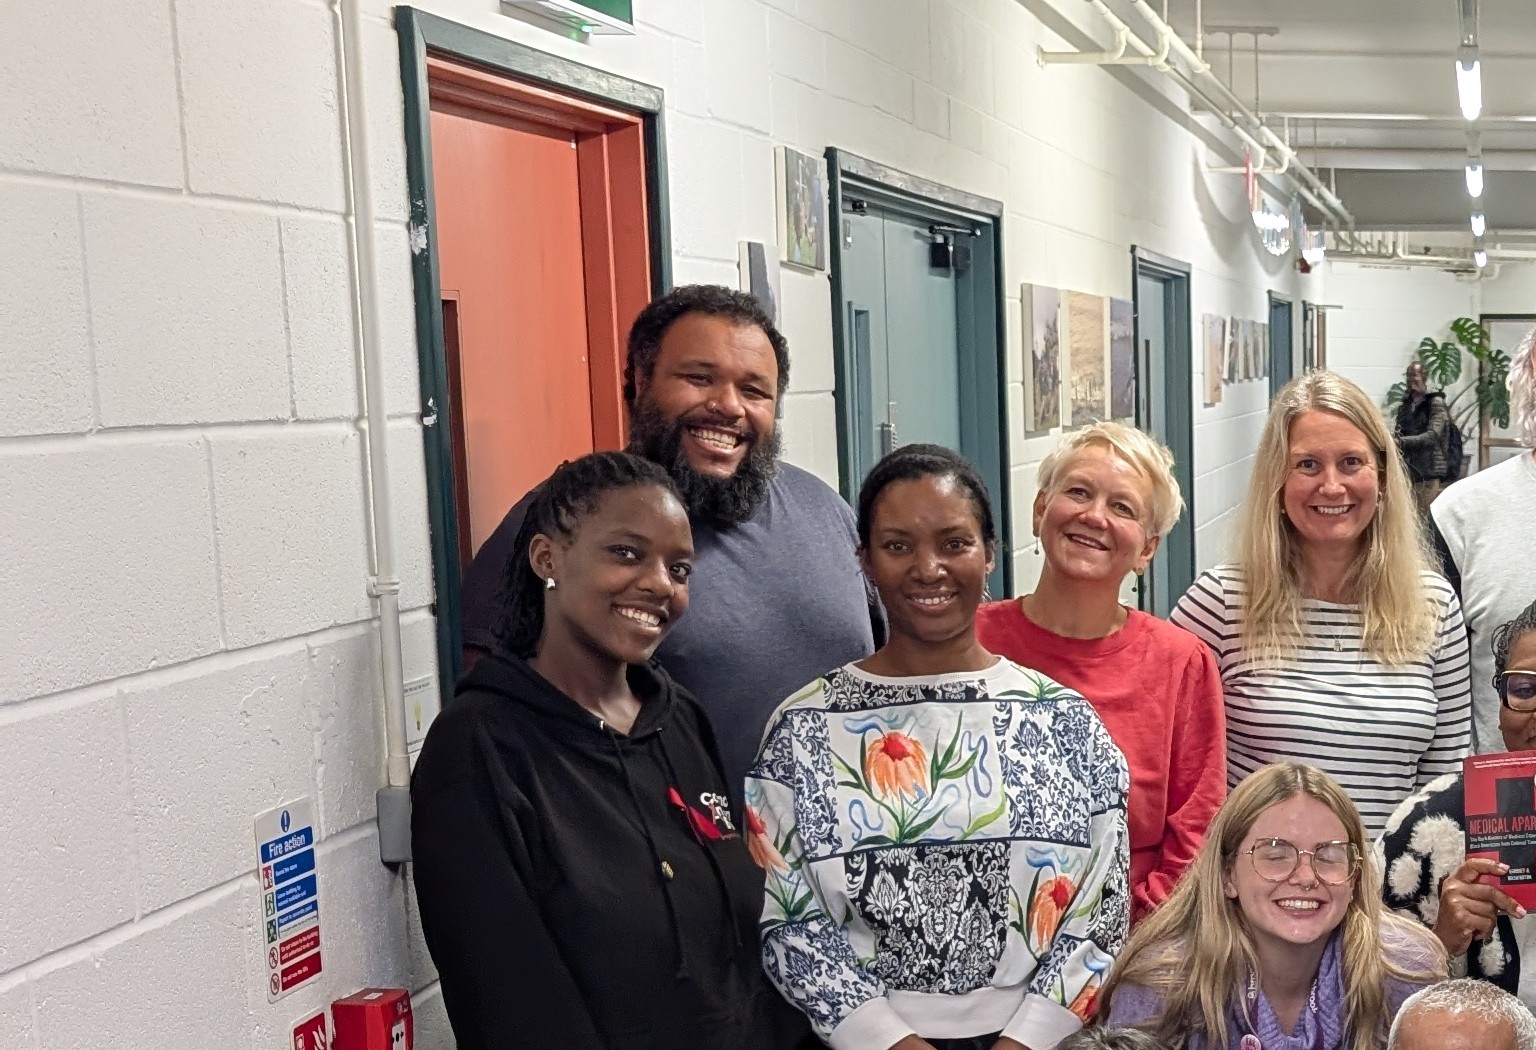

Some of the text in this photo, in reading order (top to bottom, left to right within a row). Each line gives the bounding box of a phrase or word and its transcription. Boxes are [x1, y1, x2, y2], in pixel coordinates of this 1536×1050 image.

[1469, 817, 1510, 835] MEDICAL
[268, 834, 306, 858] Fire action
